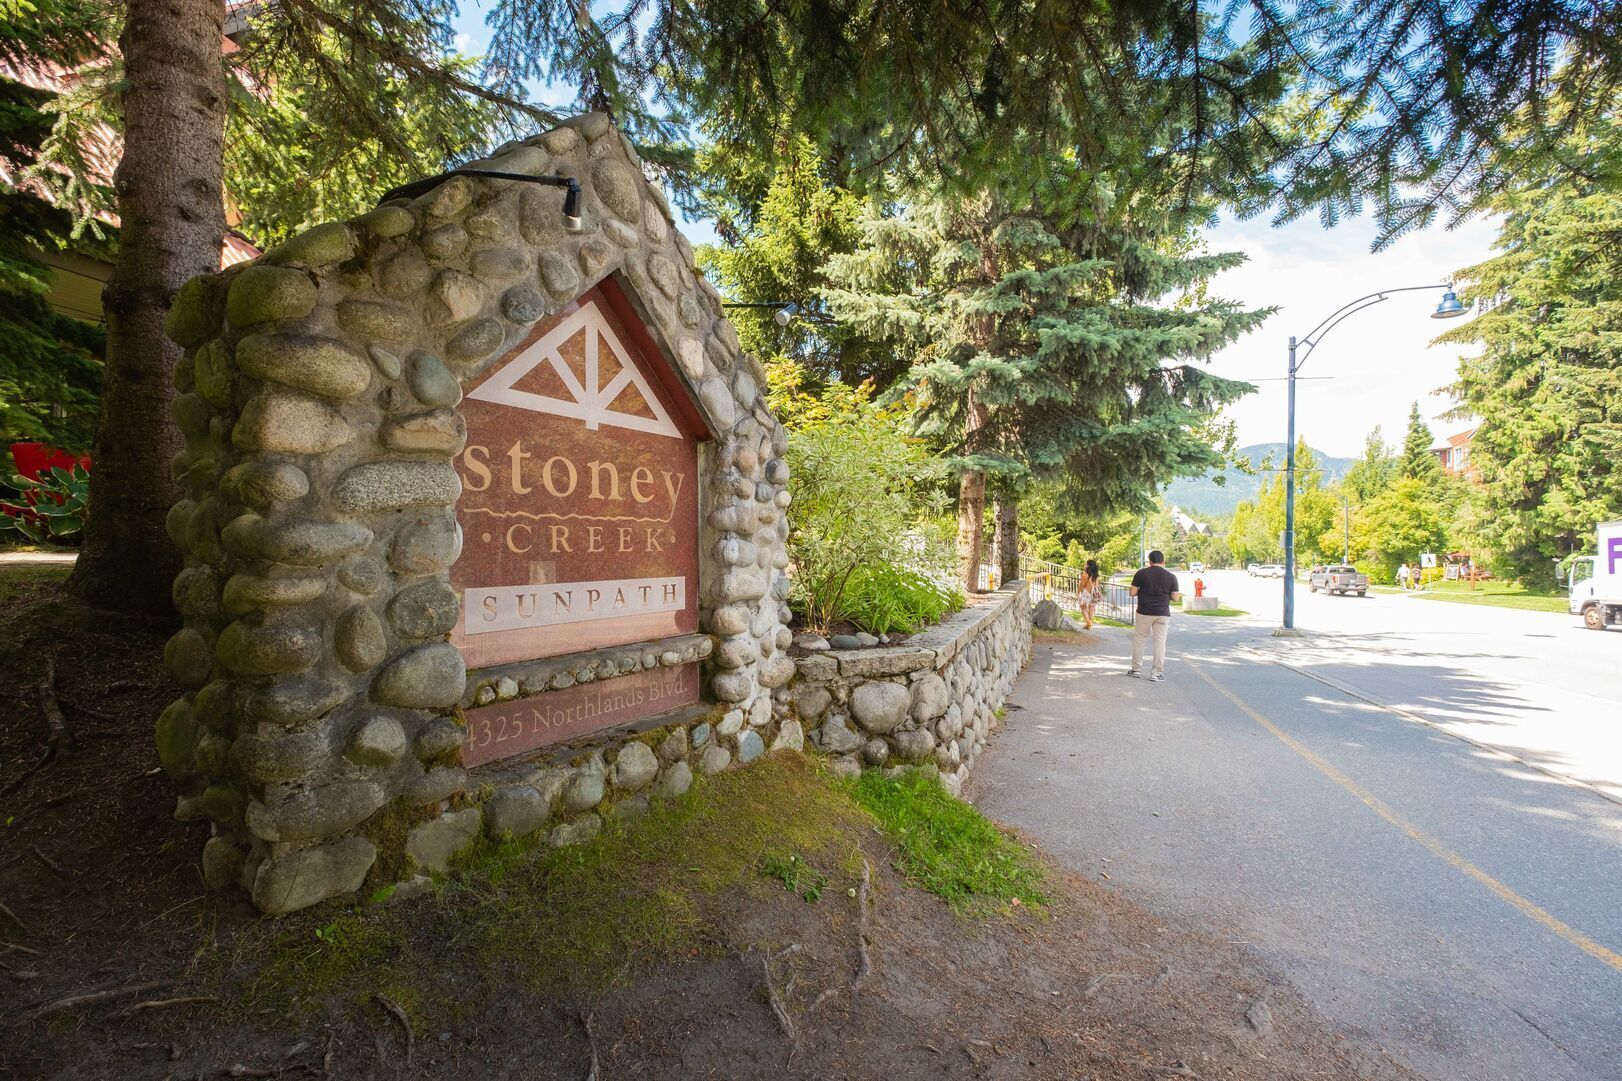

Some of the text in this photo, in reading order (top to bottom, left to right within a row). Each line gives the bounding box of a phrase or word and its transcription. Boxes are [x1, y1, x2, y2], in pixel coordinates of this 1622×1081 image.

[506, 523, 663, 553] CREEK
[482, 583, 677, 622] SUNPATH
[531, 687, 643, 733] Northlands
[648, 679, 688, 701] Blvd.
